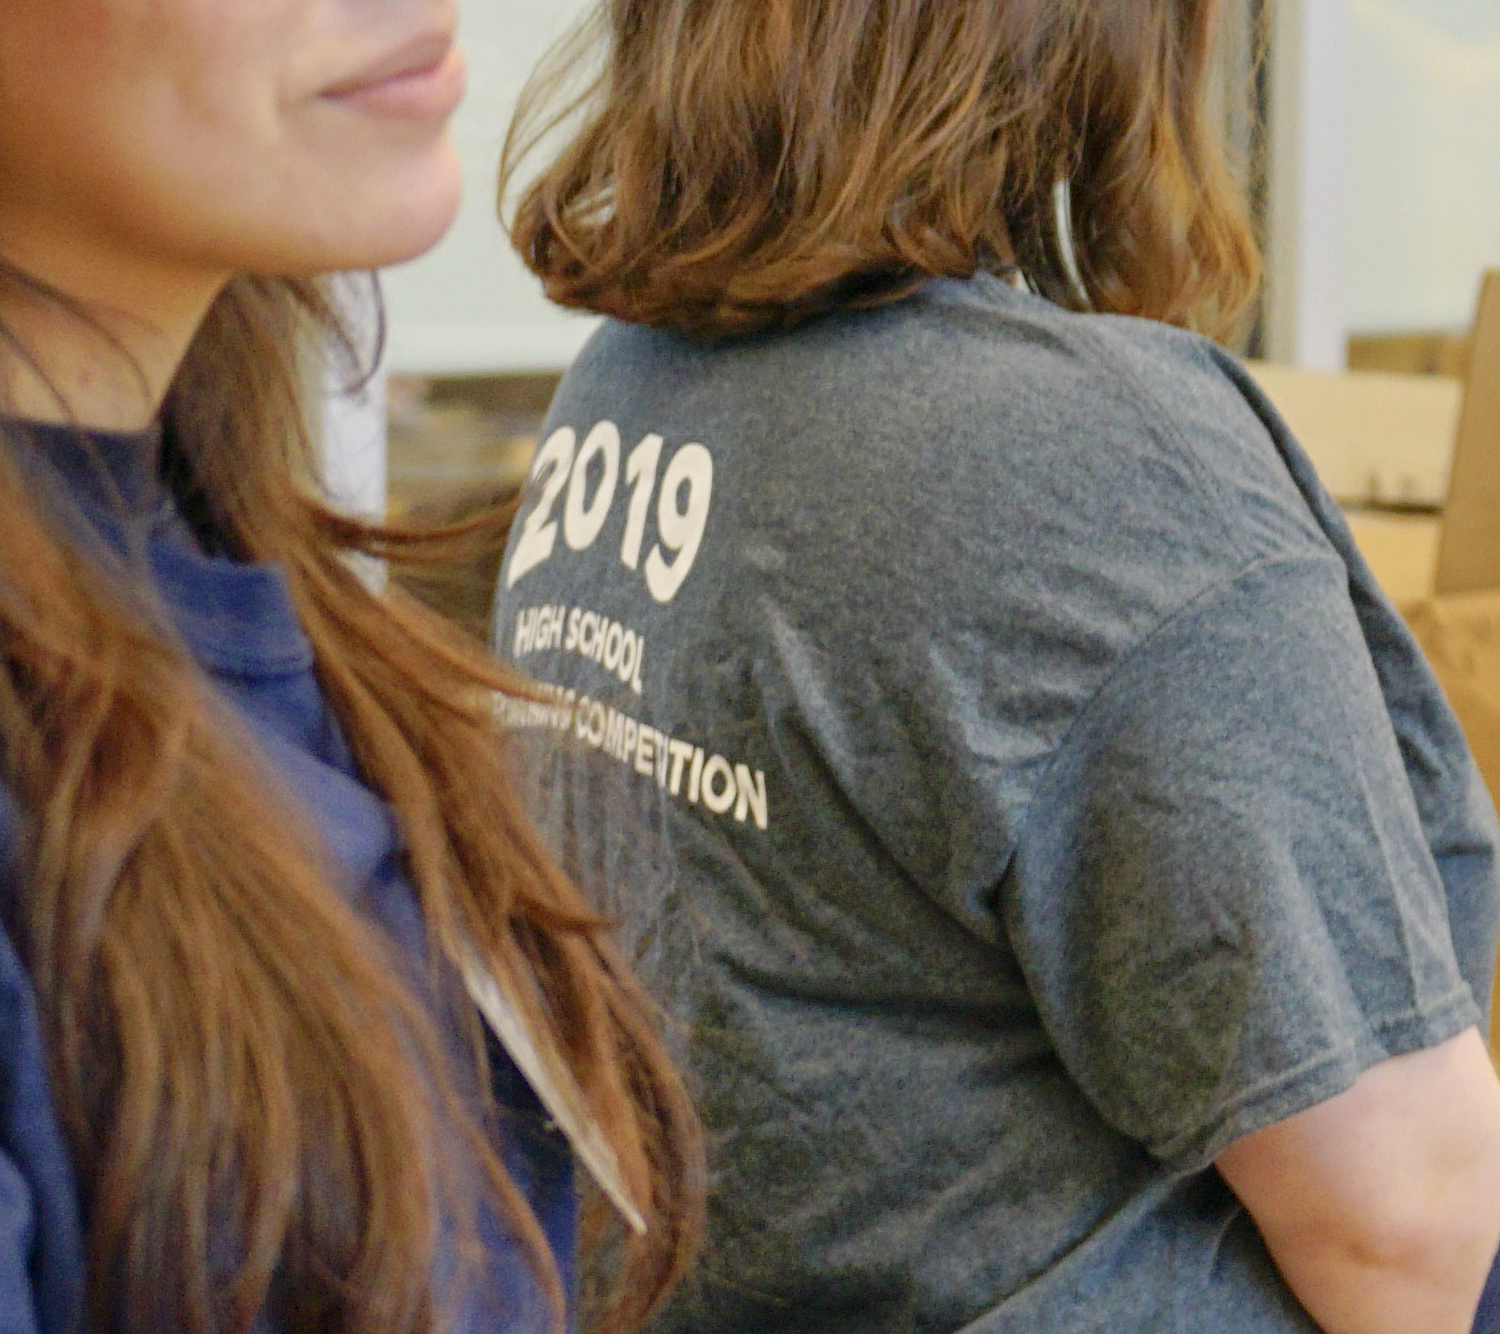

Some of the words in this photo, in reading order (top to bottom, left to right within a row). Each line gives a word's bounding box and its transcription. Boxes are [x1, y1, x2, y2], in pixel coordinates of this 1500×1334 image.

[507, 420, 713, 602] 2019
[512, 604, 566, 660] HIGH
[565, 606, 644, 695] SCHOOL
[575, 695, 767, 829] COMPETITION
